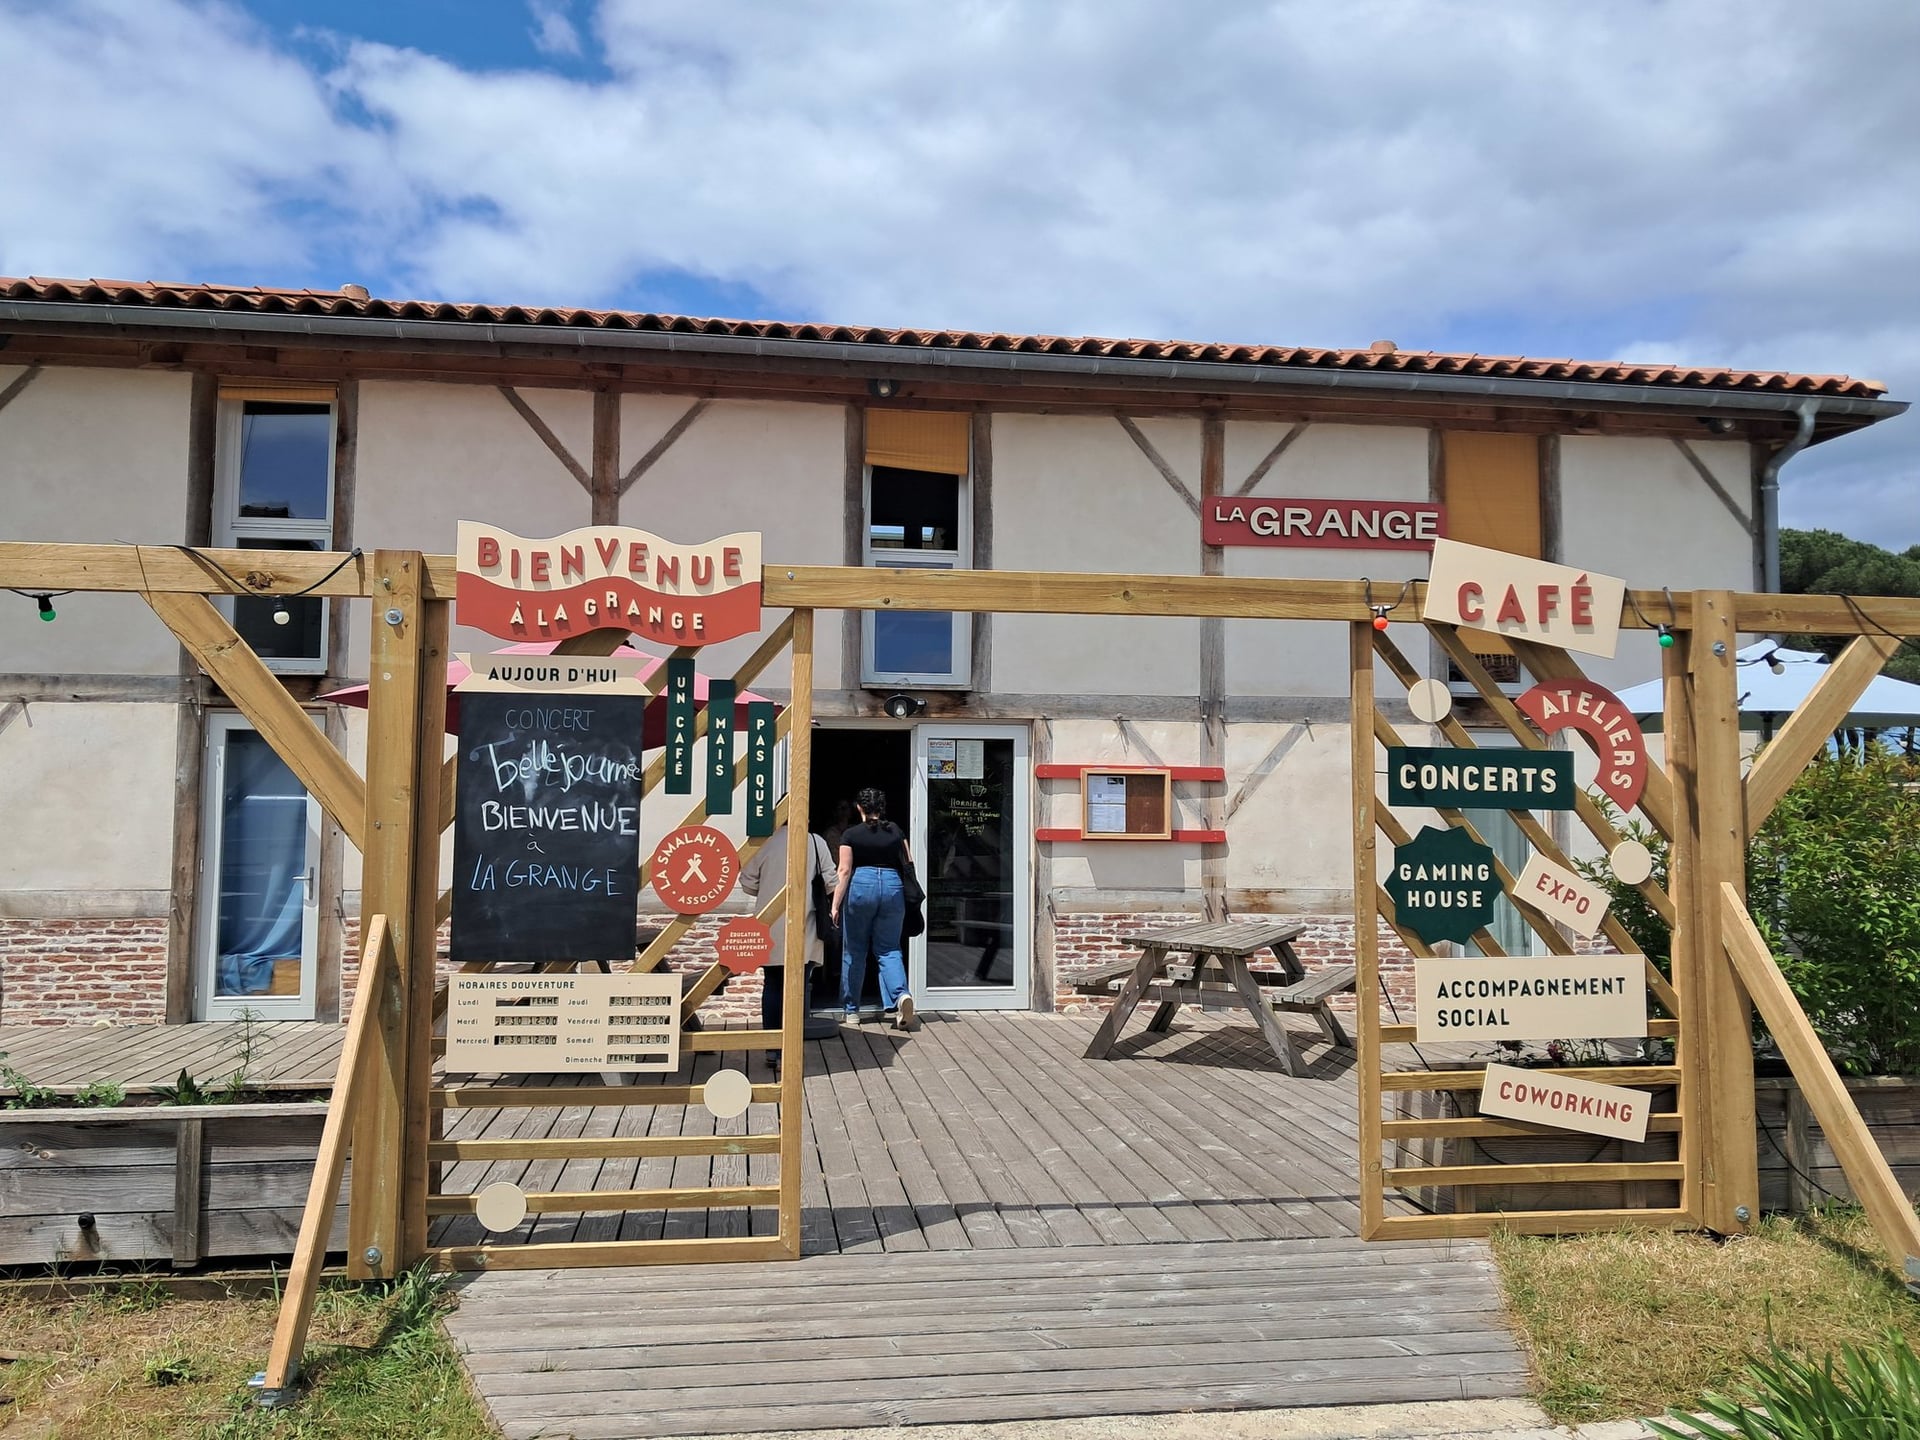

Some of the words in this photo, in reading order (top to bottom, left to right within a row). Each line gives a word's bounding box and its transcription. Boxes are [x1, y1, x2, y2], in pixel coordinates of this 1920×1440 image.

[1215, 505, 1246, 522] LA
[1249, 507, 1439, 540] GRANGE
[477, 536, 742, 586] BIENVENUE
[509, 601, 524, 625] À
[537, 603, 568, 627] LA
[583, 590, 704, 630] GRANGE
[1457, 573, 1593, 626] CAFÉ
[488, 666, 560, 682] AUJOUR
[568, 668, 617, 683] D'HUI
[676, 676, 686, 704] UN
[505, 708, 596, 732] CONCERT
[674, 716, 685, 776] CAFÉ
[715, 717, 726, 777] MAIS
[755, 718, 766, 762] PAS
[1542, 689, 1636, 790] ATELIERS
[755, 774, 765, 817] QUE
[1400, 764, 1557, 793] CONCERTS
[481, 800, 638, 836] BIENVENUE
[657, 831, 717, 865] SMALAH
[470, 853, 495, 891] LA
[505, 859, 624, 896] GRANGE
[656, 869, 671, 890] LA
[677, 856, 730, 905] ASSOCIATION
[1400, 863, 1490, 882] GAMING
[1407, 890, 1483, 908] HOUSE
[1535, 872, 1591, 915] EXPO
[458, 981, 508, 990] HORAIRES
[511, 981, 575, 990] DOUVERTURE
[1437, 976, 1626, 999] ACCOMPAGNEMENT
[1437, 1008, 1510, 1027] SOCIAL
[1500, 1080, 1633, 1123] COWORKING
